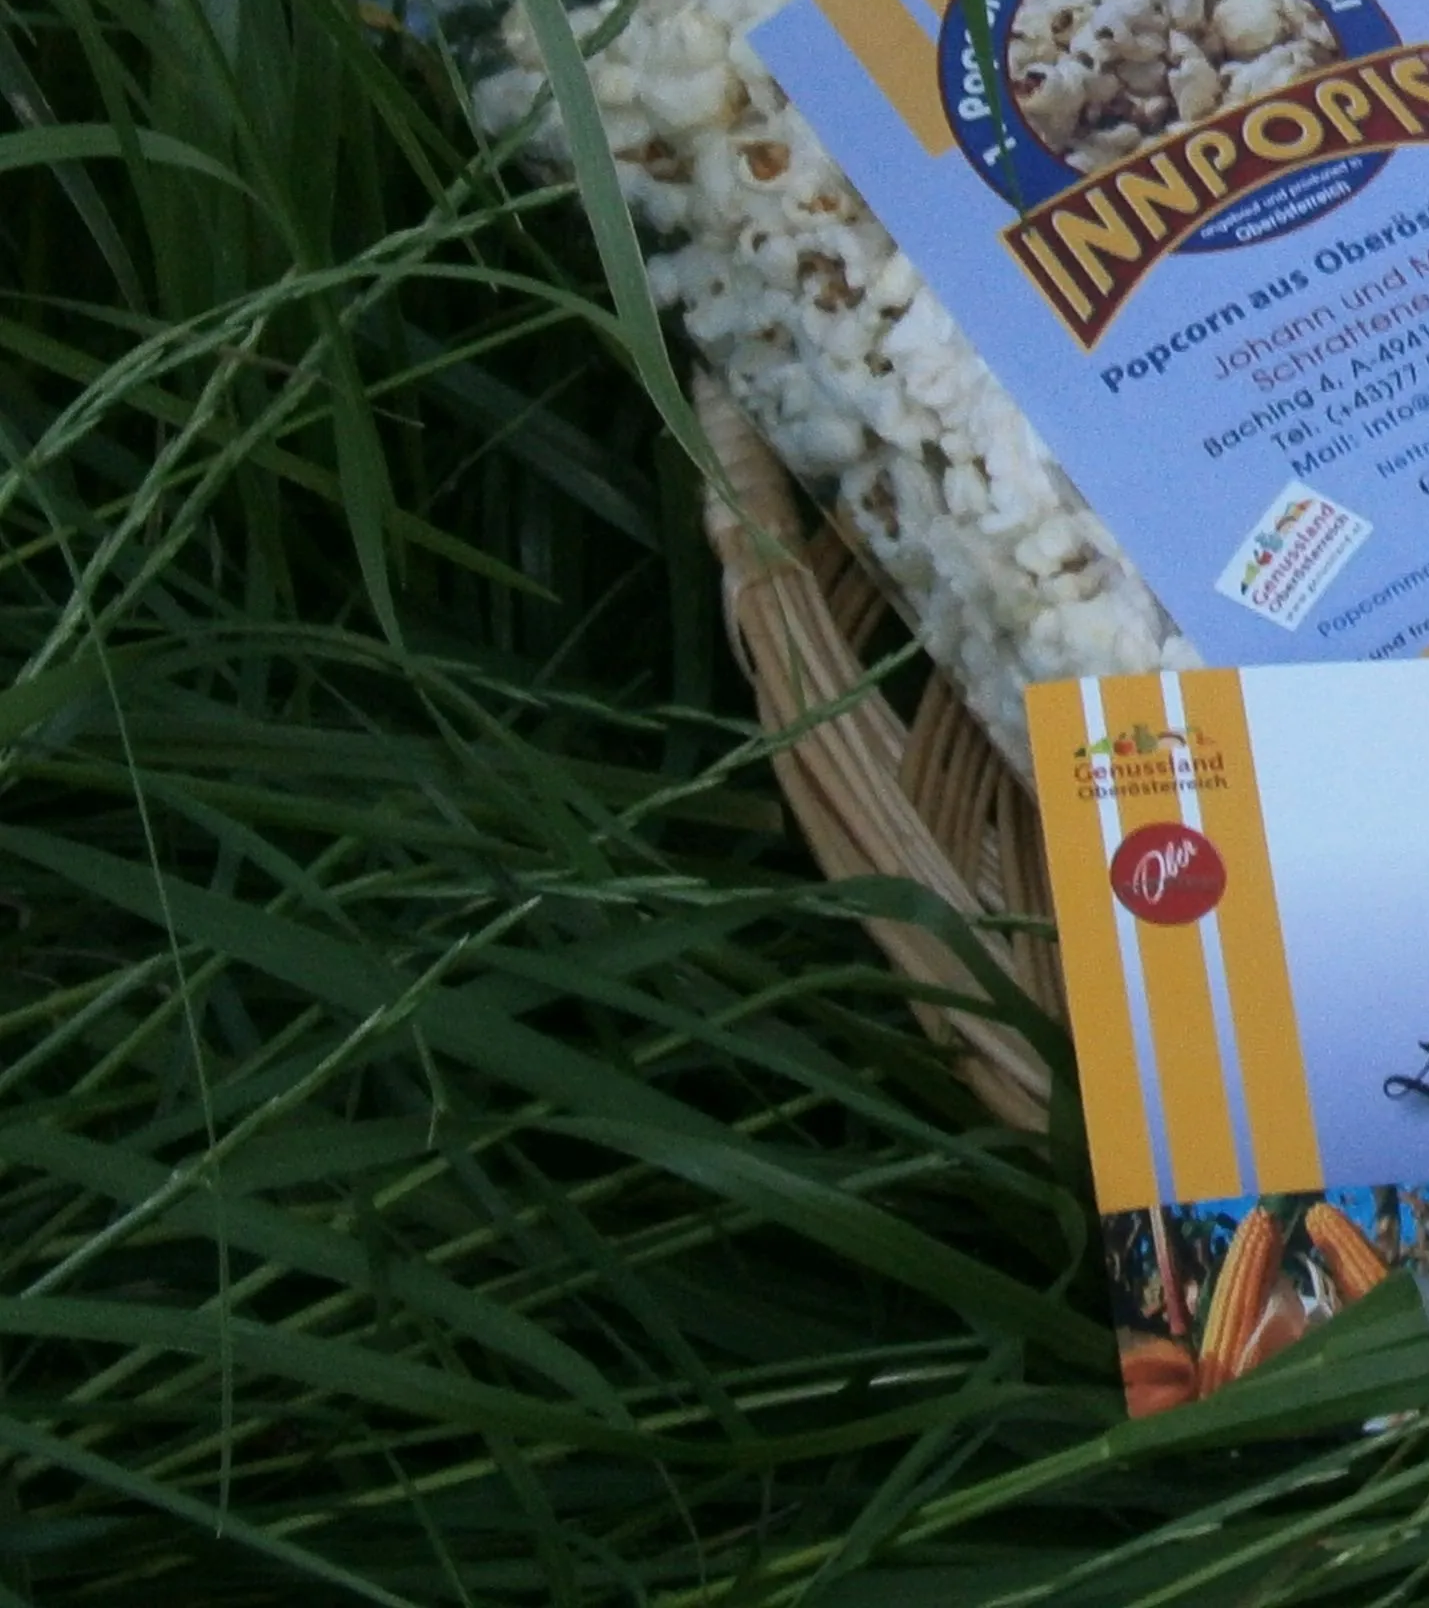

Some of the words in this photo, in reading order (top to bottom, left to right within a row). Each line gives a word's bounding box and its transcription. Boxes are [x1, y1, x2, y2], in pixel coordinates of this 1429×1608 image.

[1101, 302, 1247, 393] Popcorn
[1251, 269, 1309, 311] aus
[1215, 307, 1337, 380] Johann
[1341, 268, 1408, 321] und
[1203, 390, 1313, 460] Baching
[1271, 421, 1320, 455] Tel.
[1326, 360, 1420, 428] (+43)77
[1292, 435, 1360, 478] Mail:
[1074, 752, 1225, 783] Genussland
[1078, 774, 1228, 800] Oberösterreich
